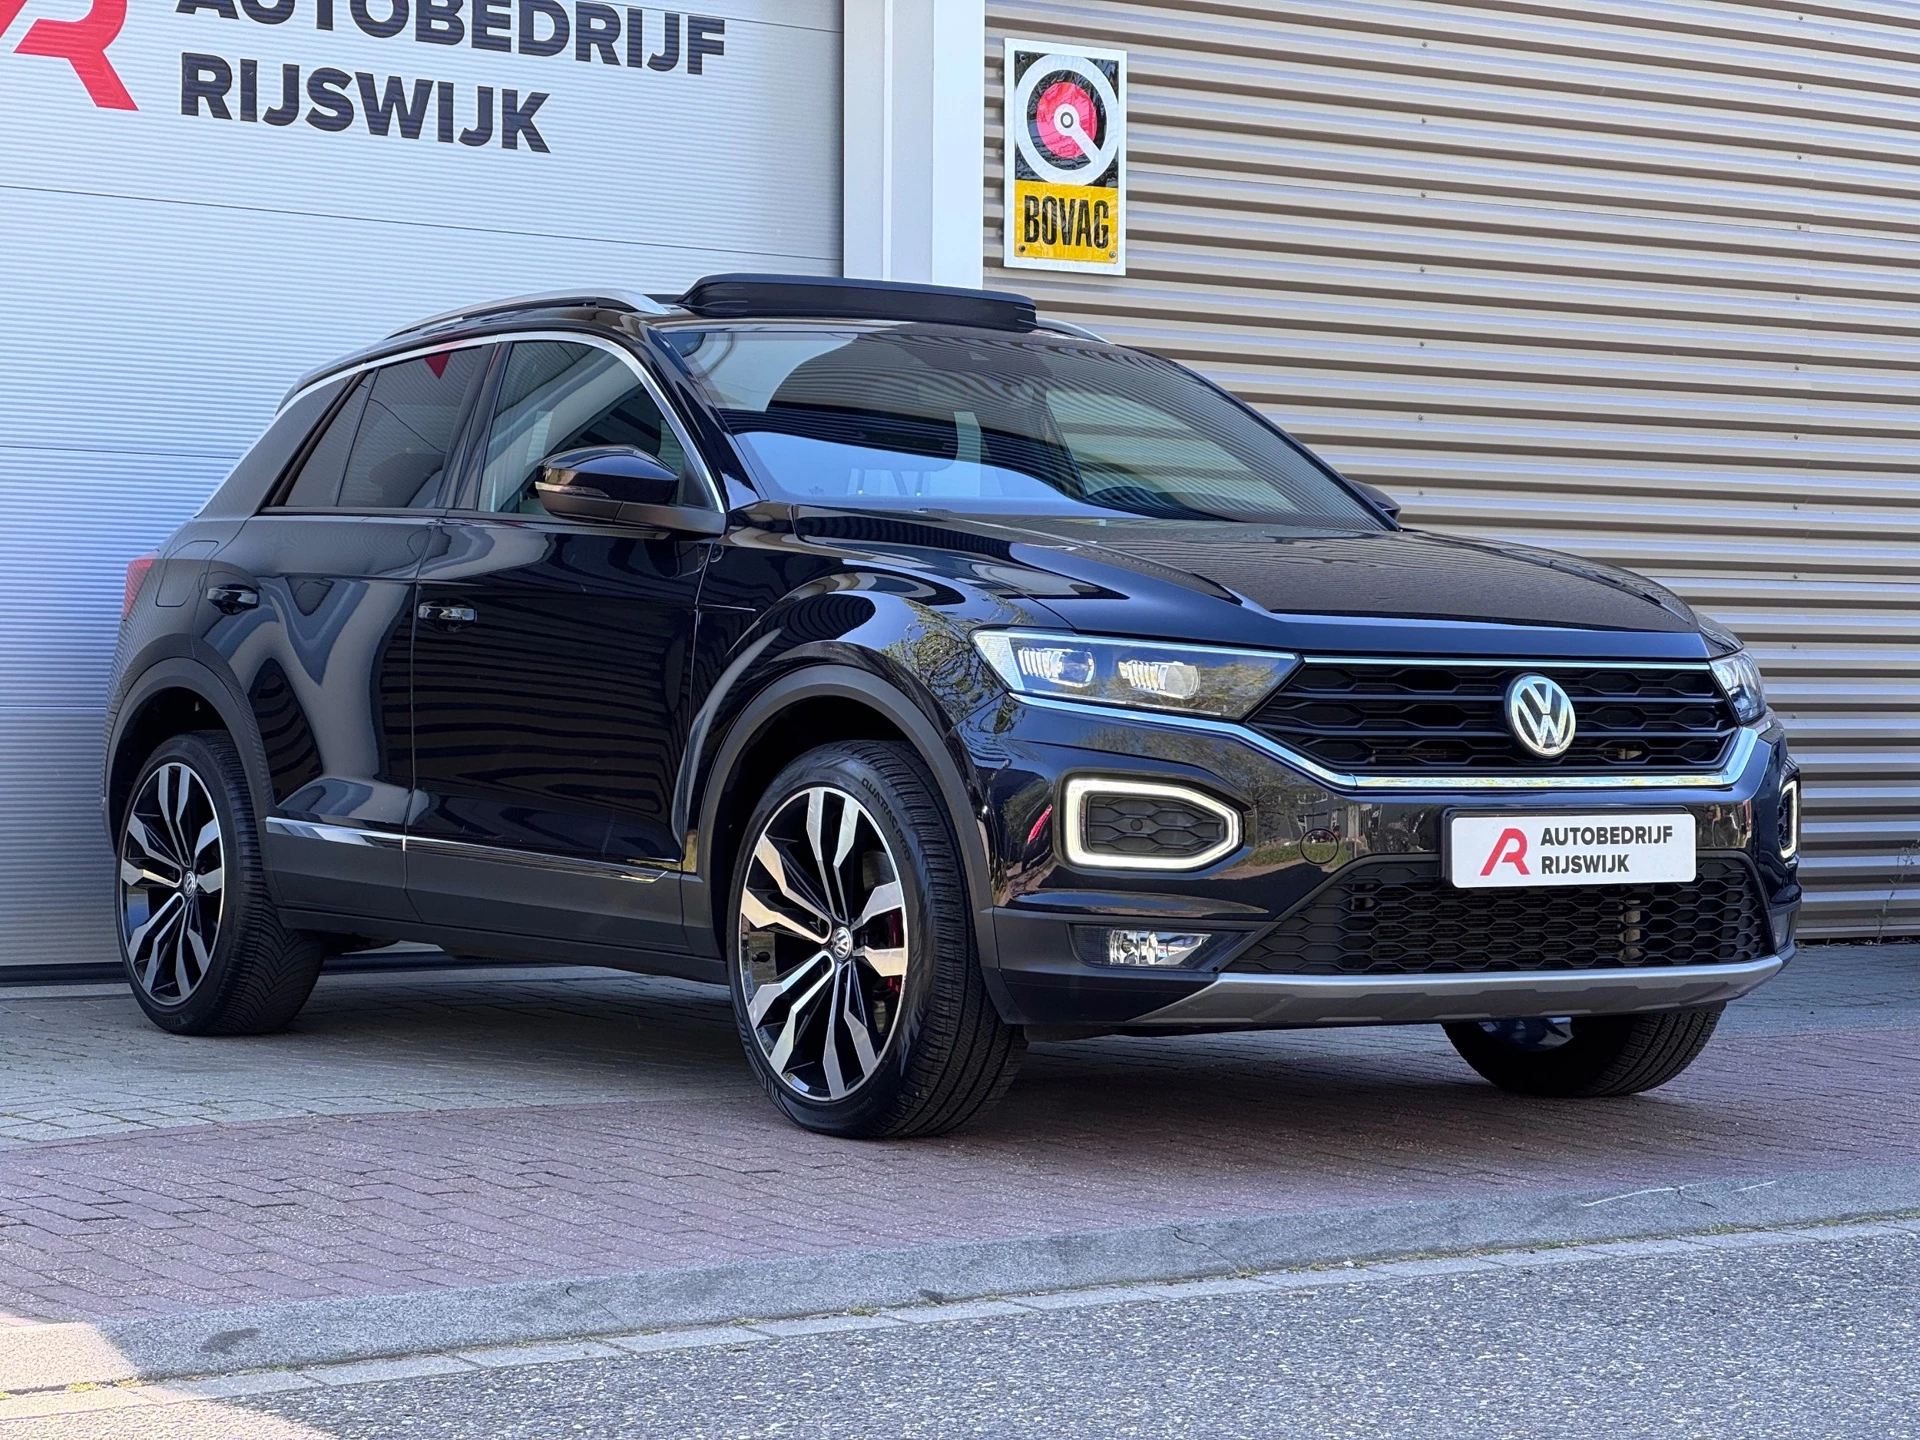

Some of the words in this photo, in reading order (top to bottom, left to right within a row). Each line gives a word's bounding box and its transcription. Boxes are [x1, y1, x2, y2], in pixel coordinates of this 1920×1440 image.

[175, 0, 726, 75] OBEDRIJF
[181, 51, 551, 154] RIJSWIJK
[1024, 195, 1109, 249] BOVAG
[1540, 825, 1673, 846] AUTOBEDRIJF
[1541, 854, 1630, 875] RIJSWIJK
